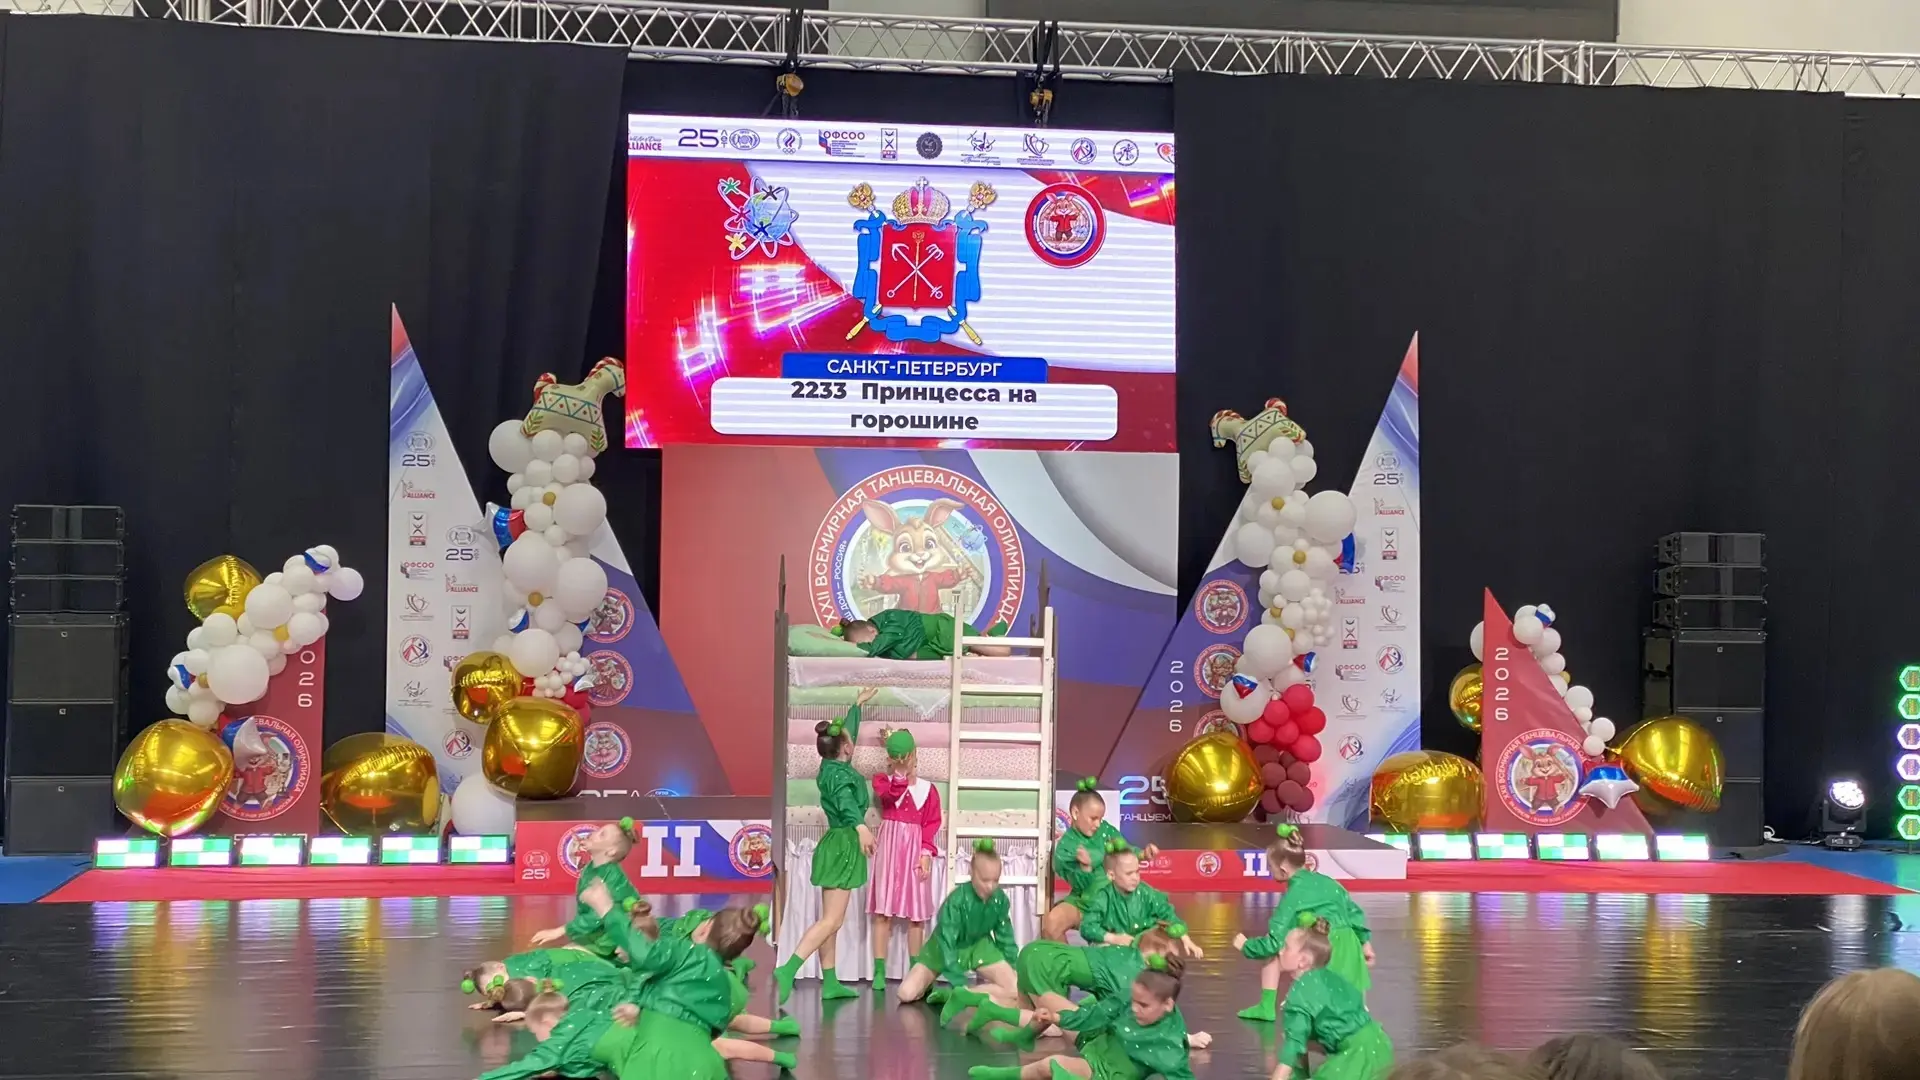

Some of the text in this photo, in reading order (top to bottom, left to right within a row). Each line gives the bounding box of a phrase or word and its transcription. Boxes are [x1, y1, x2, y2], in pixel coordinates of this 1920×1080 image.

[628, 142, 662, 151] LLIANCE
[678, 128, 719, 148] 25
[823, 130, 865, 141] ОФСОО
[826, 359, 1002, 377] САНКТ-ПЕТЕРБУРГ
[791, 381, 1037, 405] 2233 Принцесса на
[850, 411, 979, 431] горошине
[402, 454, 430, 467] 25
[1373, 473, 1399, 485] 25
[867, 469, 997, 516] ТАНЦЕВАЛЬНАЯ
[815, 487, 868, 586] ВСЕМИРНАЯ
[445, 548, 474, 561] 25
[816, 591, 839, 624] XXII
[297, 650, 316, 708] 026
[1494, 647, 1510, 721] 2026
[1169, 660, 1184, 733] 2026
[294, 739, 308, 792] ОЛИМПИАДА
[1498, 739, 1522, 784] ВСЕМИРНАЯ
[1520, 730, 1581, 751] ТАНЦЕВАЛЬНАЯ
[640, 826, 700, 877] II
[522, 868, 546, 880] 25
